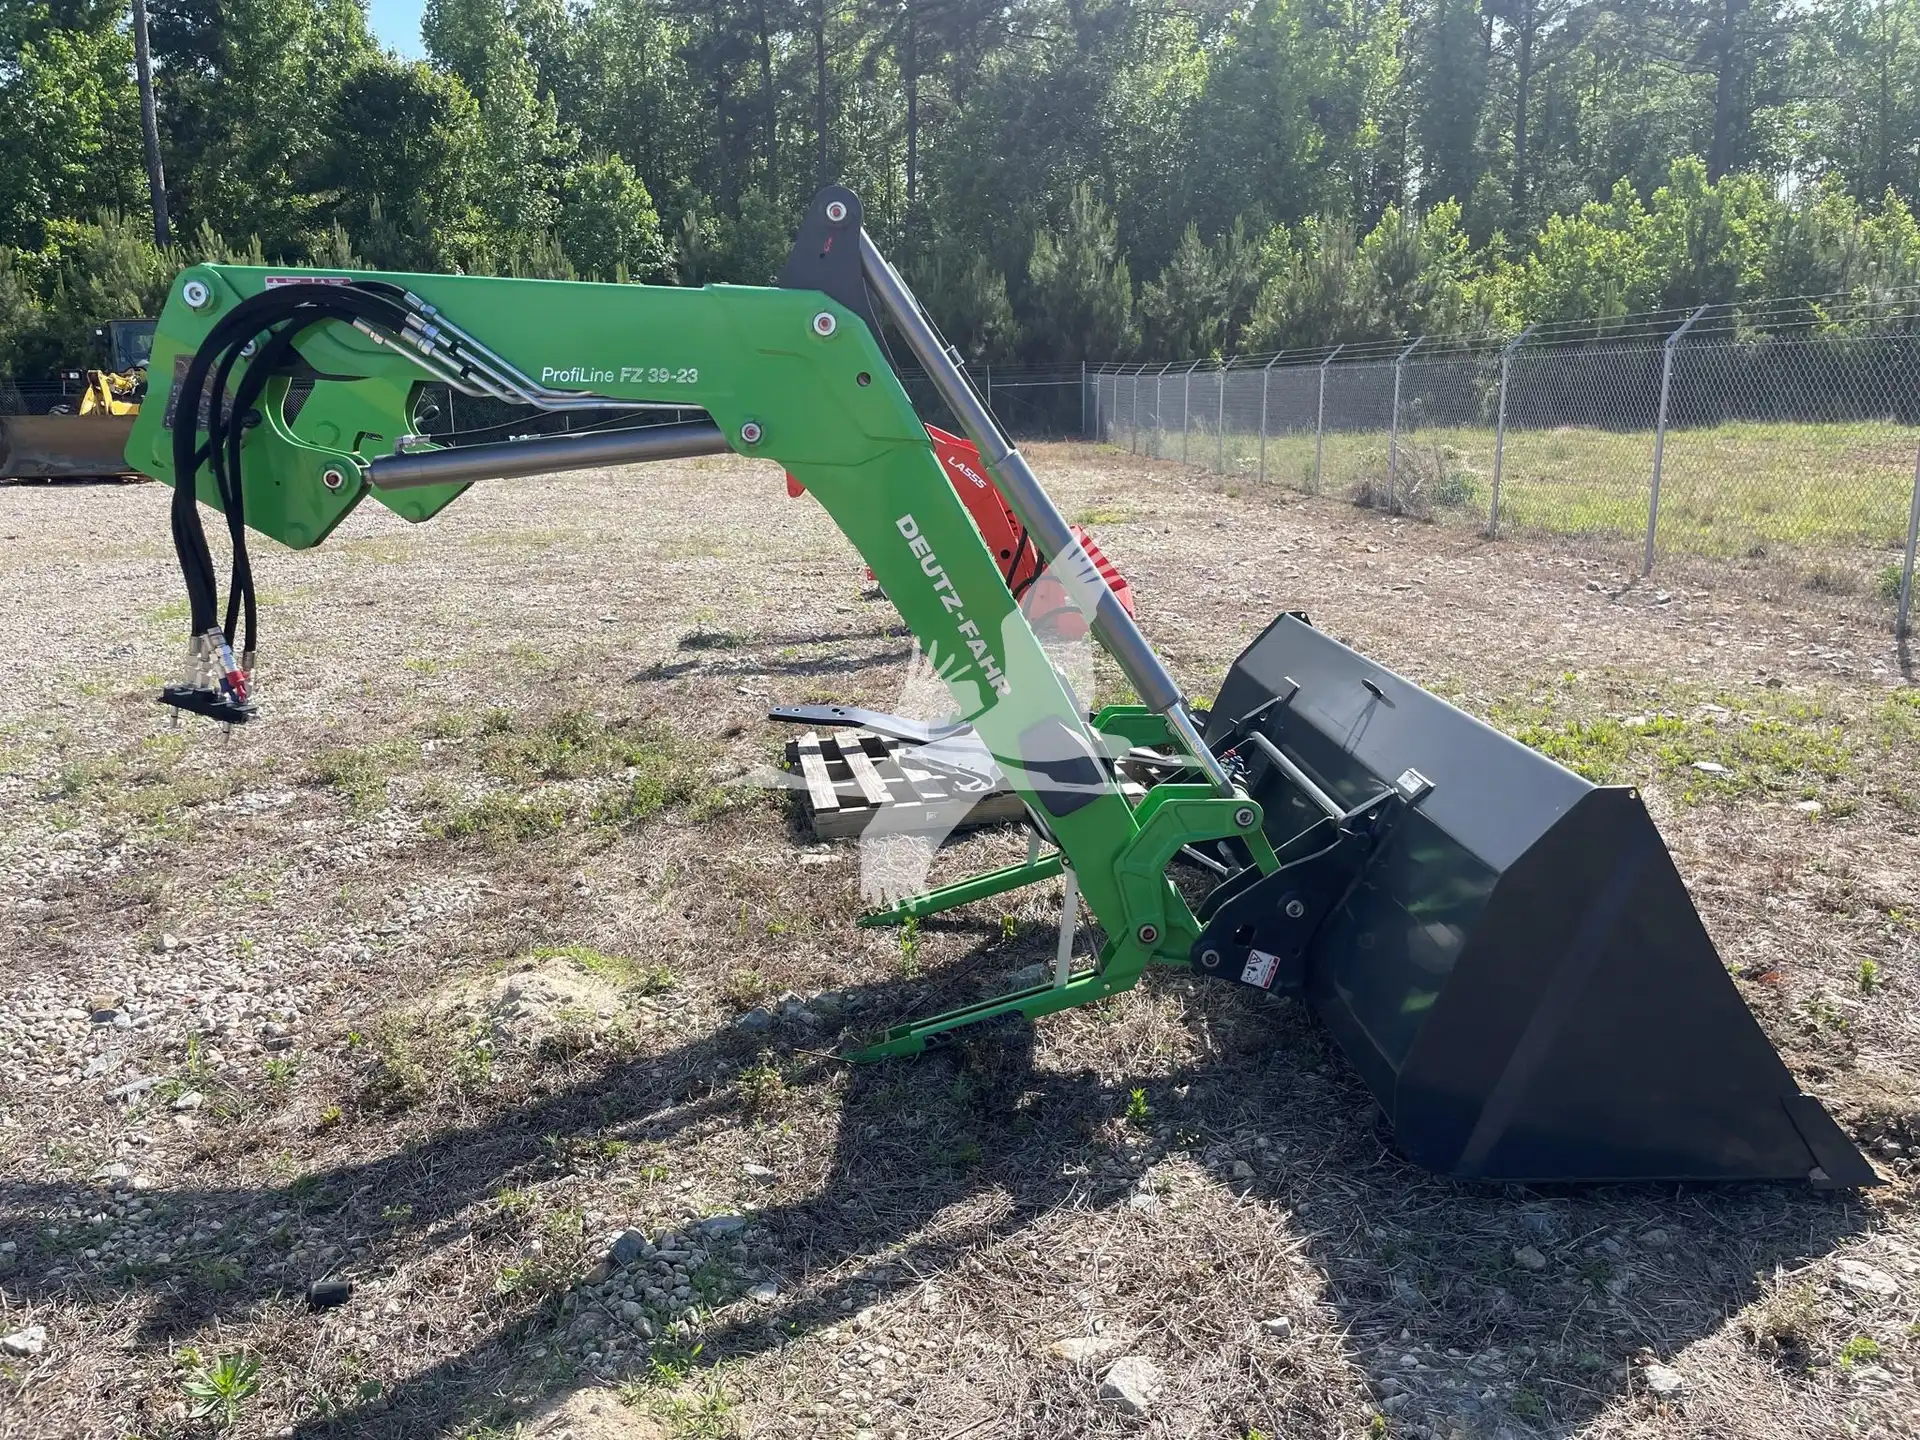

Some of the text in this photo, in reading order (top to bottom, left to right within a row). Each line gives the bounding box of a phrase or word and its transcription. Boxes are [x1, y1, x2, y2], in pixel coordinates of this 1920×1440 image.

[541, 367, 699, 383] ProfiLine FZ 39-23
[895, 513, 1012, 696] DEUTZ-FAHR
